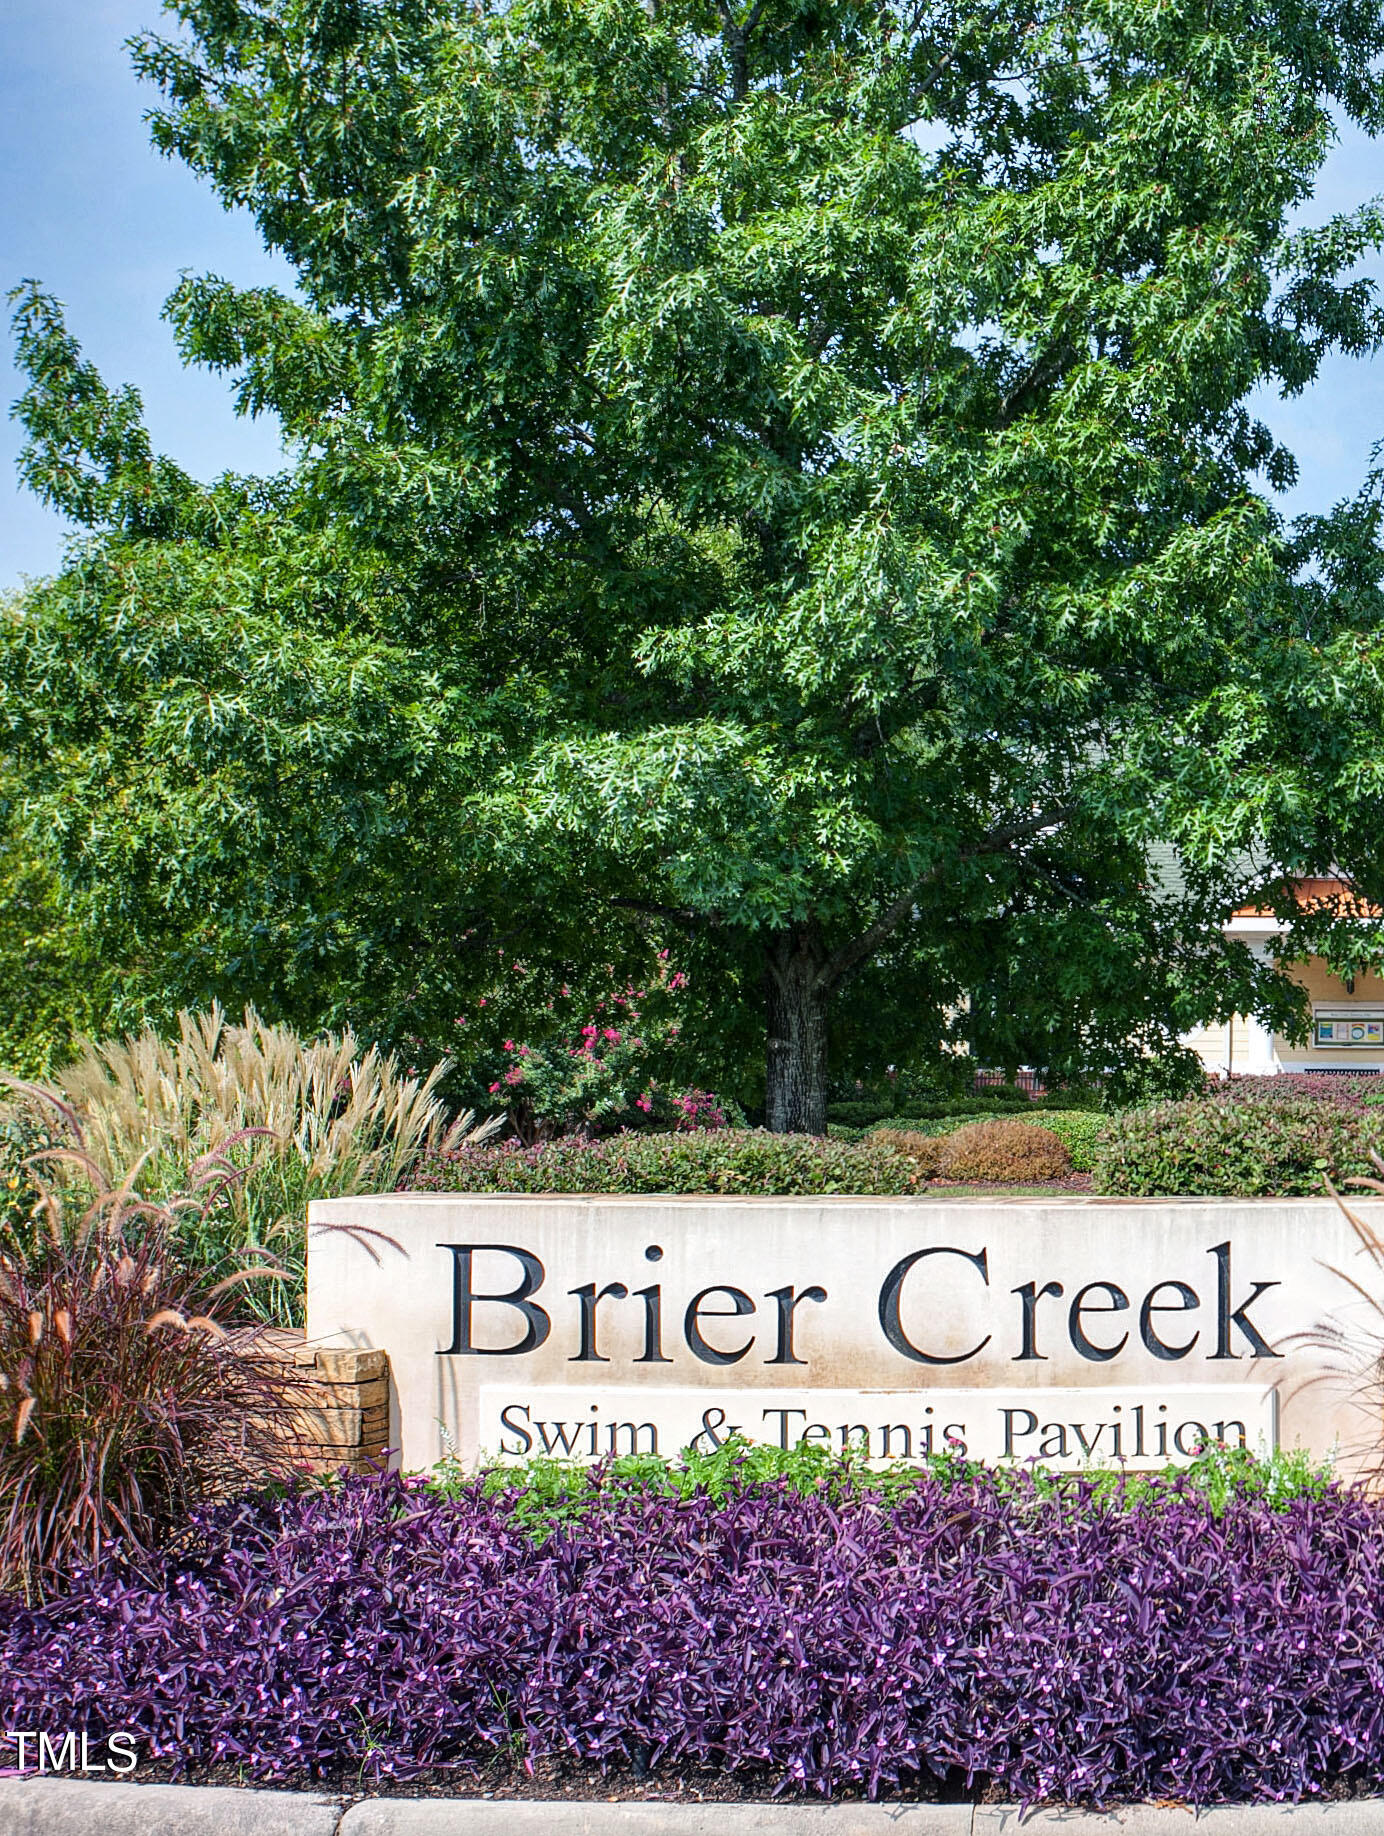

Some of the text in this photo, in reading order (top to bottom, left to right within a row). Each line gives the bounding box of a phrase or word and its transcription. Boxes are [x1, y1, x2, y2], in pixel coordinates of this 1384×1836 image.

[435, 1240, 1286, 1366] Brier Creek
[500, 1404, 1246, 1460] Swim & Tennis Pavilion
